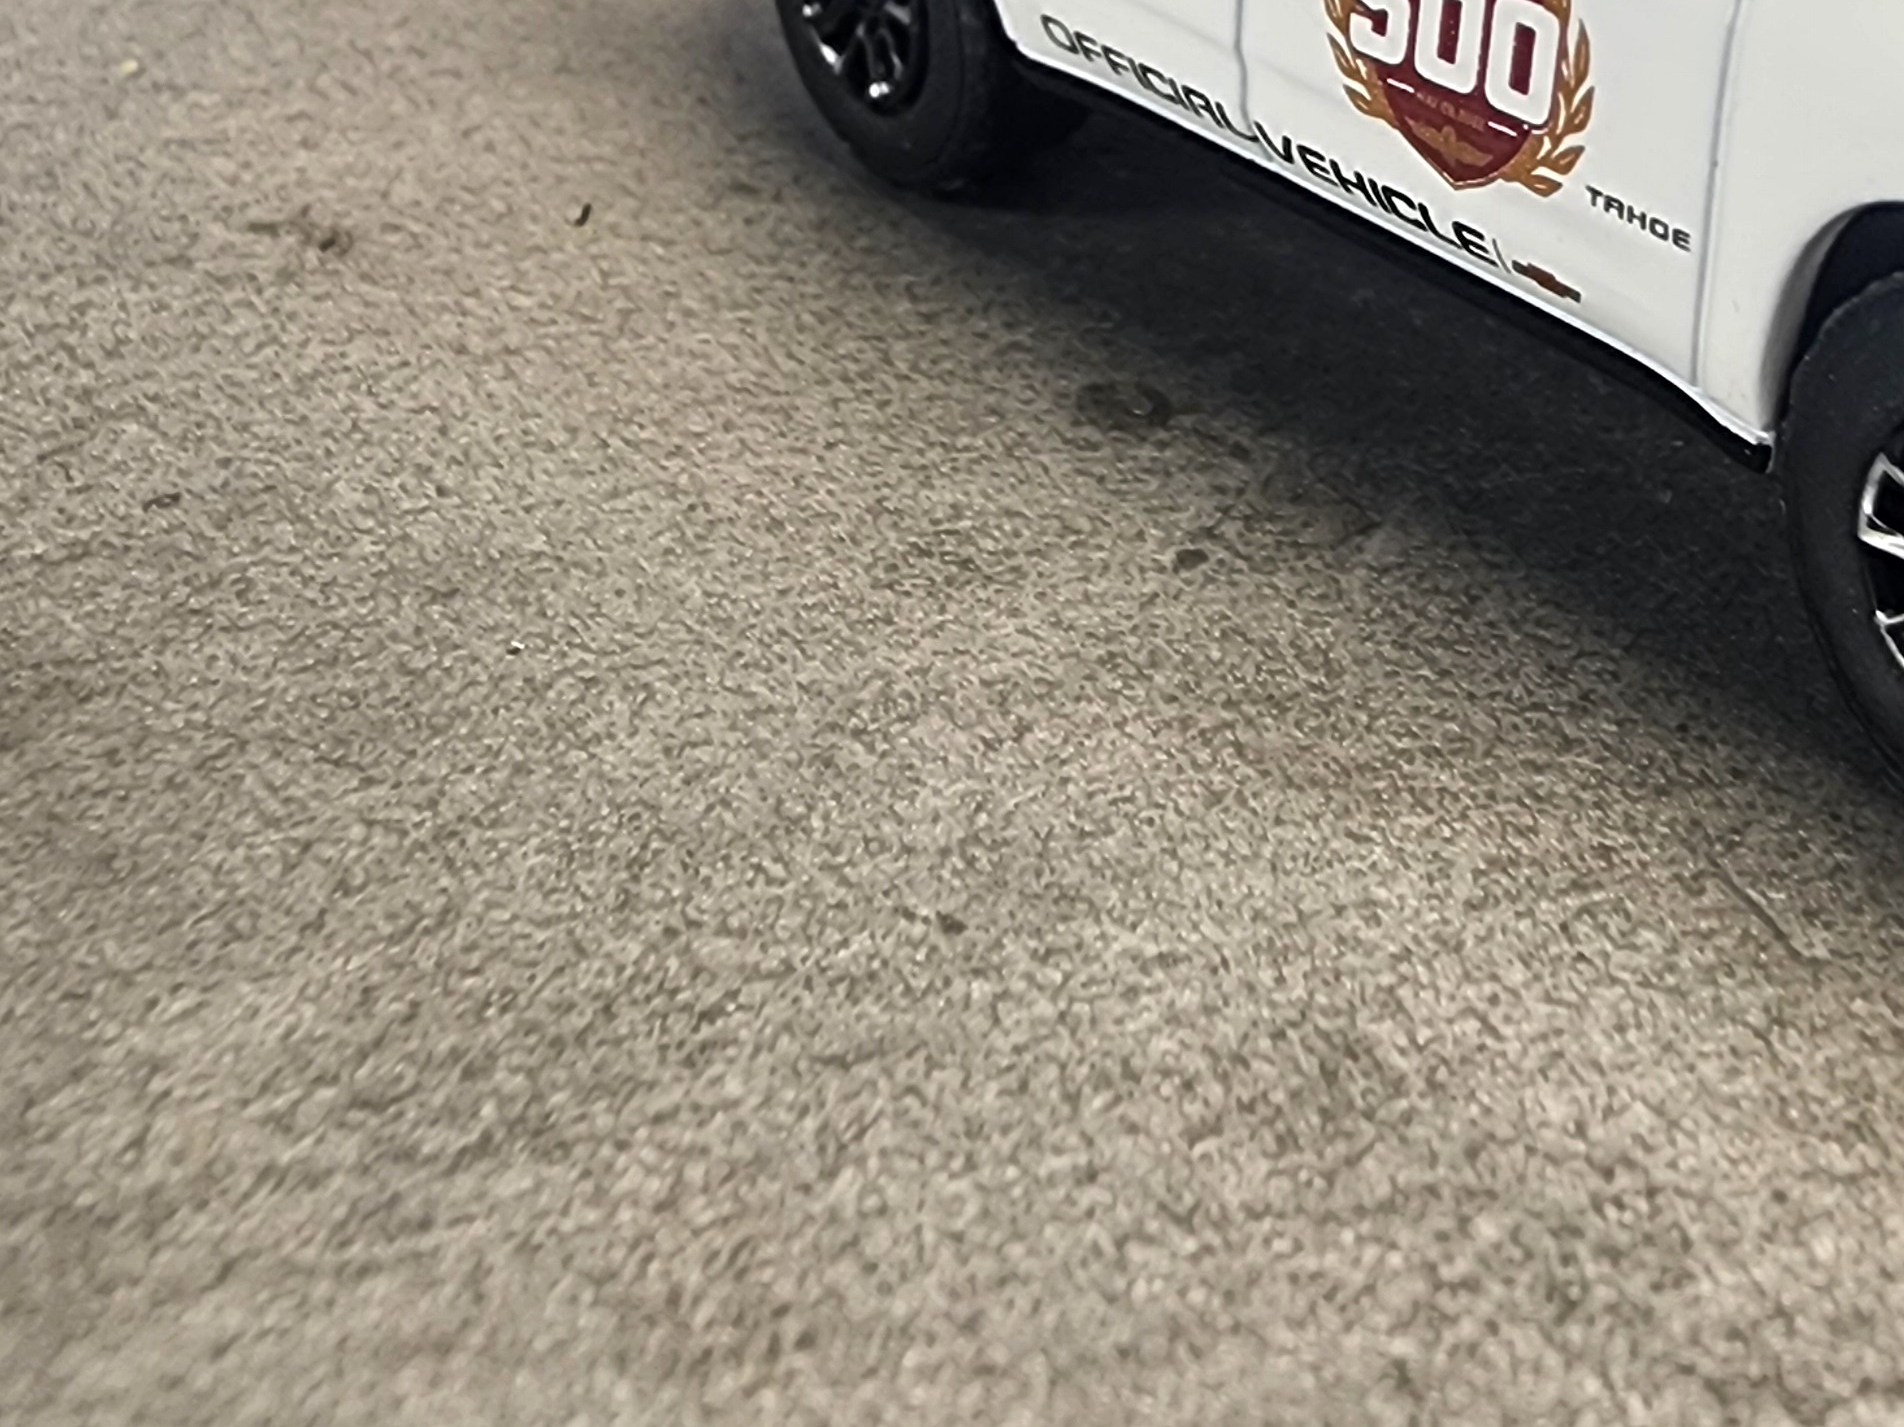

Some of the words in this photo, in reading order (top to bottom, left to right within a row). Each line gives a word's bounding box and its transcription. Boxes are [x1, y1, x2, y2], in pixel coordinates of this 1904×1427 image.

[1040, 13, 1260, 144] OFFICIAL
[1252, 119, 1500, 269] VEHICLE
[1584, 184, 1692, 253] TAHOE
